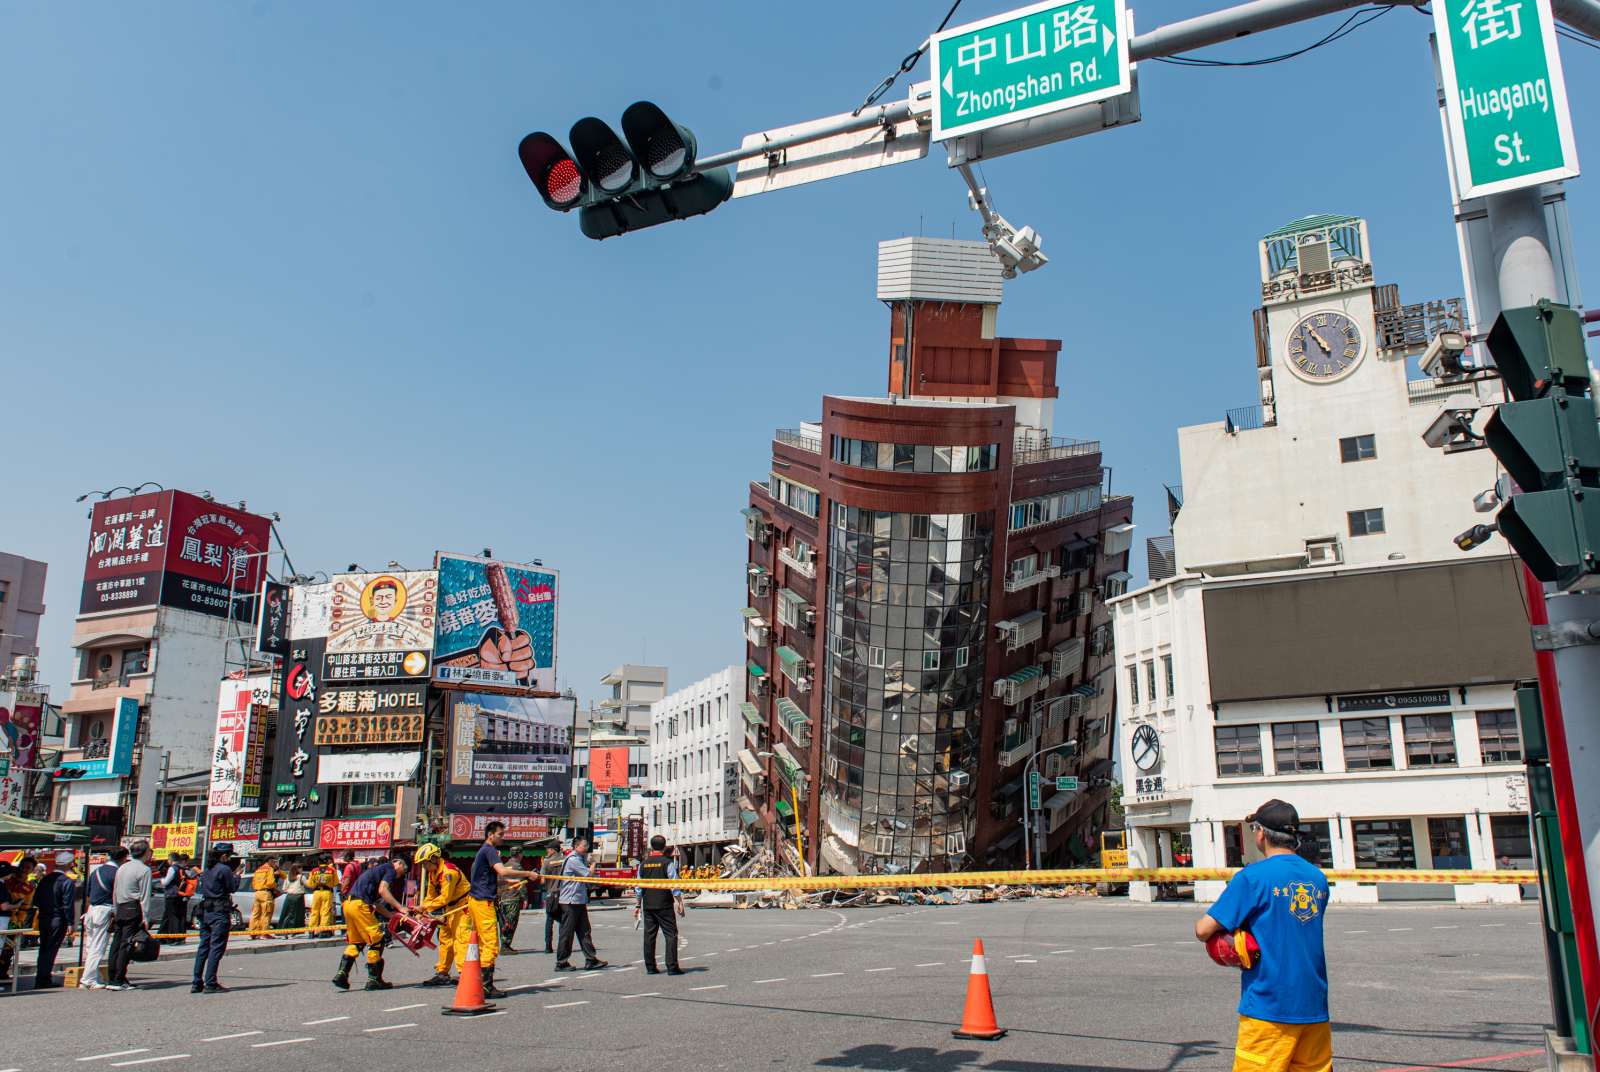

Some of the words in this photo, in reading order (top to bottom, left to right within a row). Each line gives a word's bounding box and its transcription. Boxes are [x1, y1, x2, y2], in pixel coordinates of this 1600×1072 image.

[957, 4, 1099, 76] 中山路
[956, 72, 1063, 118] Zhongshan
[1069, 56, 1102, 87] Rd.
[1460, 77, 1549, 121] Huagang
[1494, 130, 1531, 167] St.
[90, 519, 165, 559] 洄瀾薯道
[444, 583, 493, 607] 最好吃的
[439, 597, 500, 637] 燒番麥
[318, 689, 378, 714] 多羅滿
[377, 692, 424, 709] HOTEL
